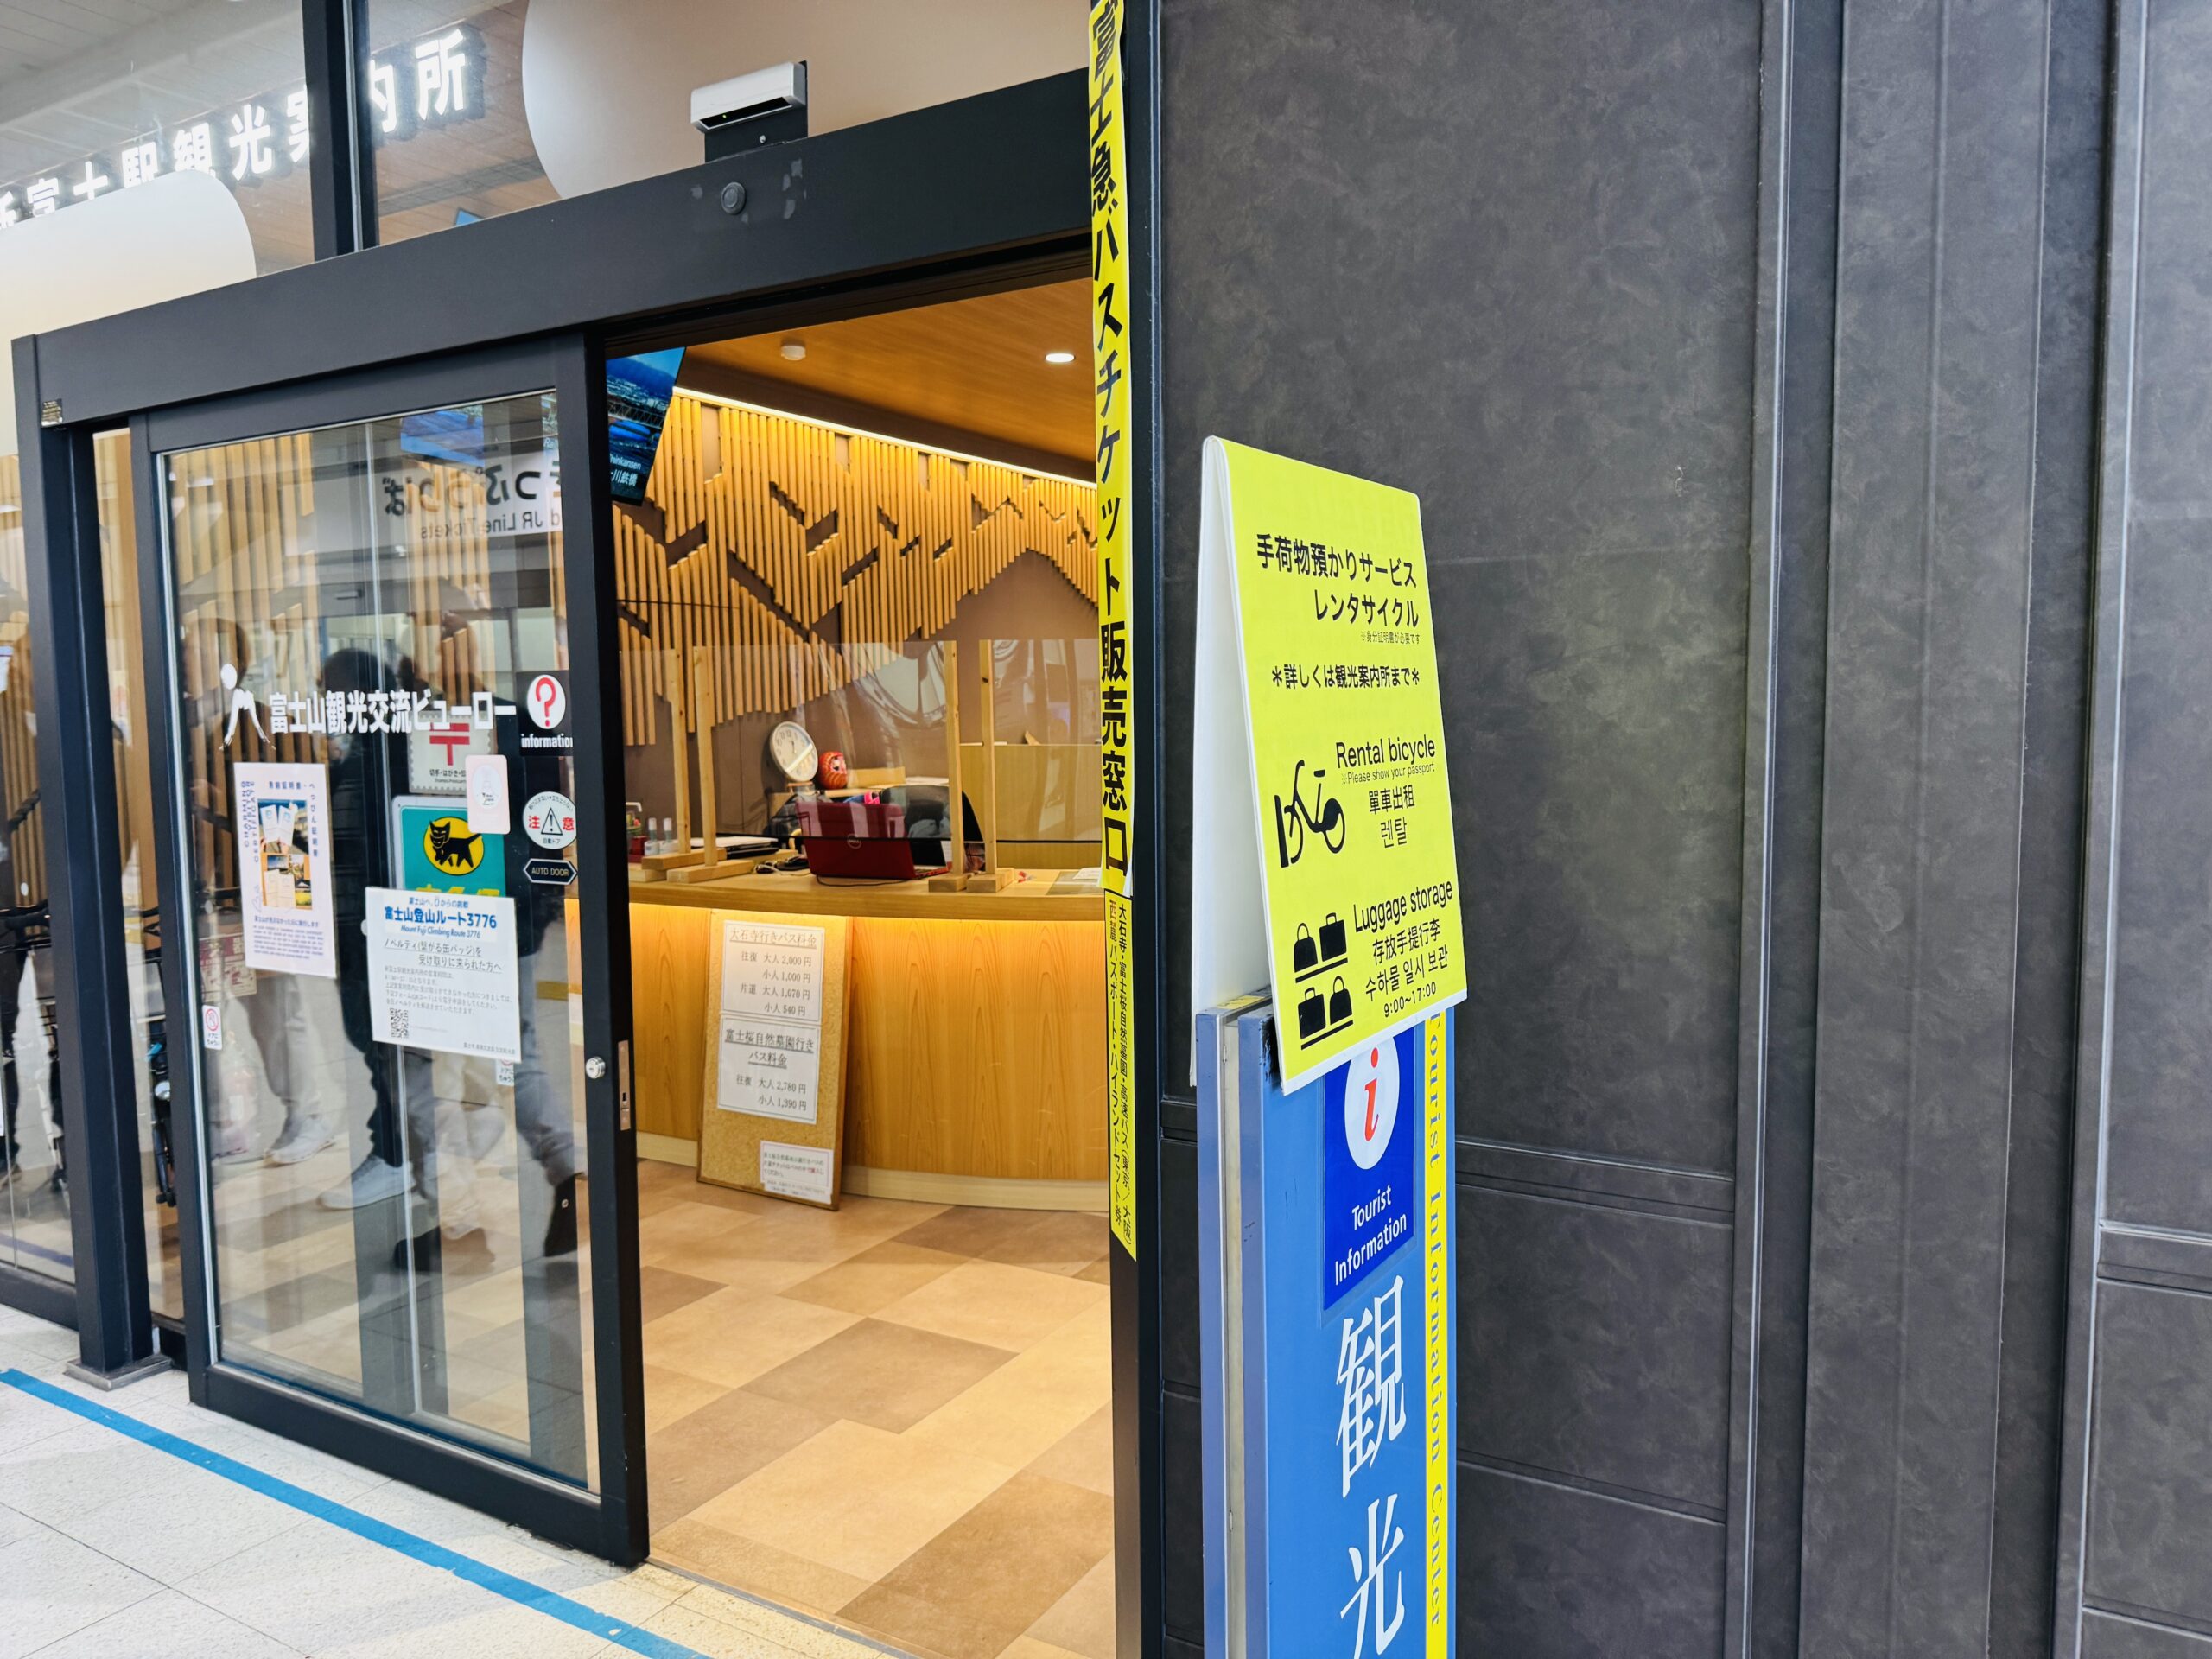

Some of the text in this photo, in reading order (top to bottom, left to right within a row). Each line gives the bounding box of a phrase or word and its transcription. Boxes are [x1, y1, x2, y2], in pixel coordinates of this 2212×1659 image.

[610, 469, 638, 486] 川鉄橋
[1256, 534, 1417, 588] 手荷物預かりサービス
[1313, 588, 1420, 628] レンタサイクル
[270, 689, 517, 734] 富士山観光交流ビューロー
[1336, 734, 1436, 769] Rental bicycle
[1372, 768, 1389, 781] show
[1390, 767, 1407, 781] your
[1407, 762, 1435, 779] passport
[1369, 785, 1415, 815] 單車出租
[1380, 817, 1408, 849] 렌탈
[531, 867, 569, 877] AUTO DOOR
[385, 906, 497, 929] 富士山登山ルート3776
[1353, 880, 1453, 933] Luggage storage
[401, 925, 416, 933] Mount
[417, 925, 428, 936] Fuji
[450, 929, 467, 938] Route
[467, 930, 480, 938] 3776
[1373, 918, 1441, 966] 存放手提行李
[1365, 944, 1448, 1002] 수하물 일시 보관
[748, 1051, 787, 1066] バス料金
[1351, 1184, 1392, 1231] Tourist
[1335, 1214, 1408, 1287] Information
[1429, 1188, 1445, 1465] Information
[1335, 1274, 1407, 1659] 観光
[1430, 1483, 1446, 1627] Center
